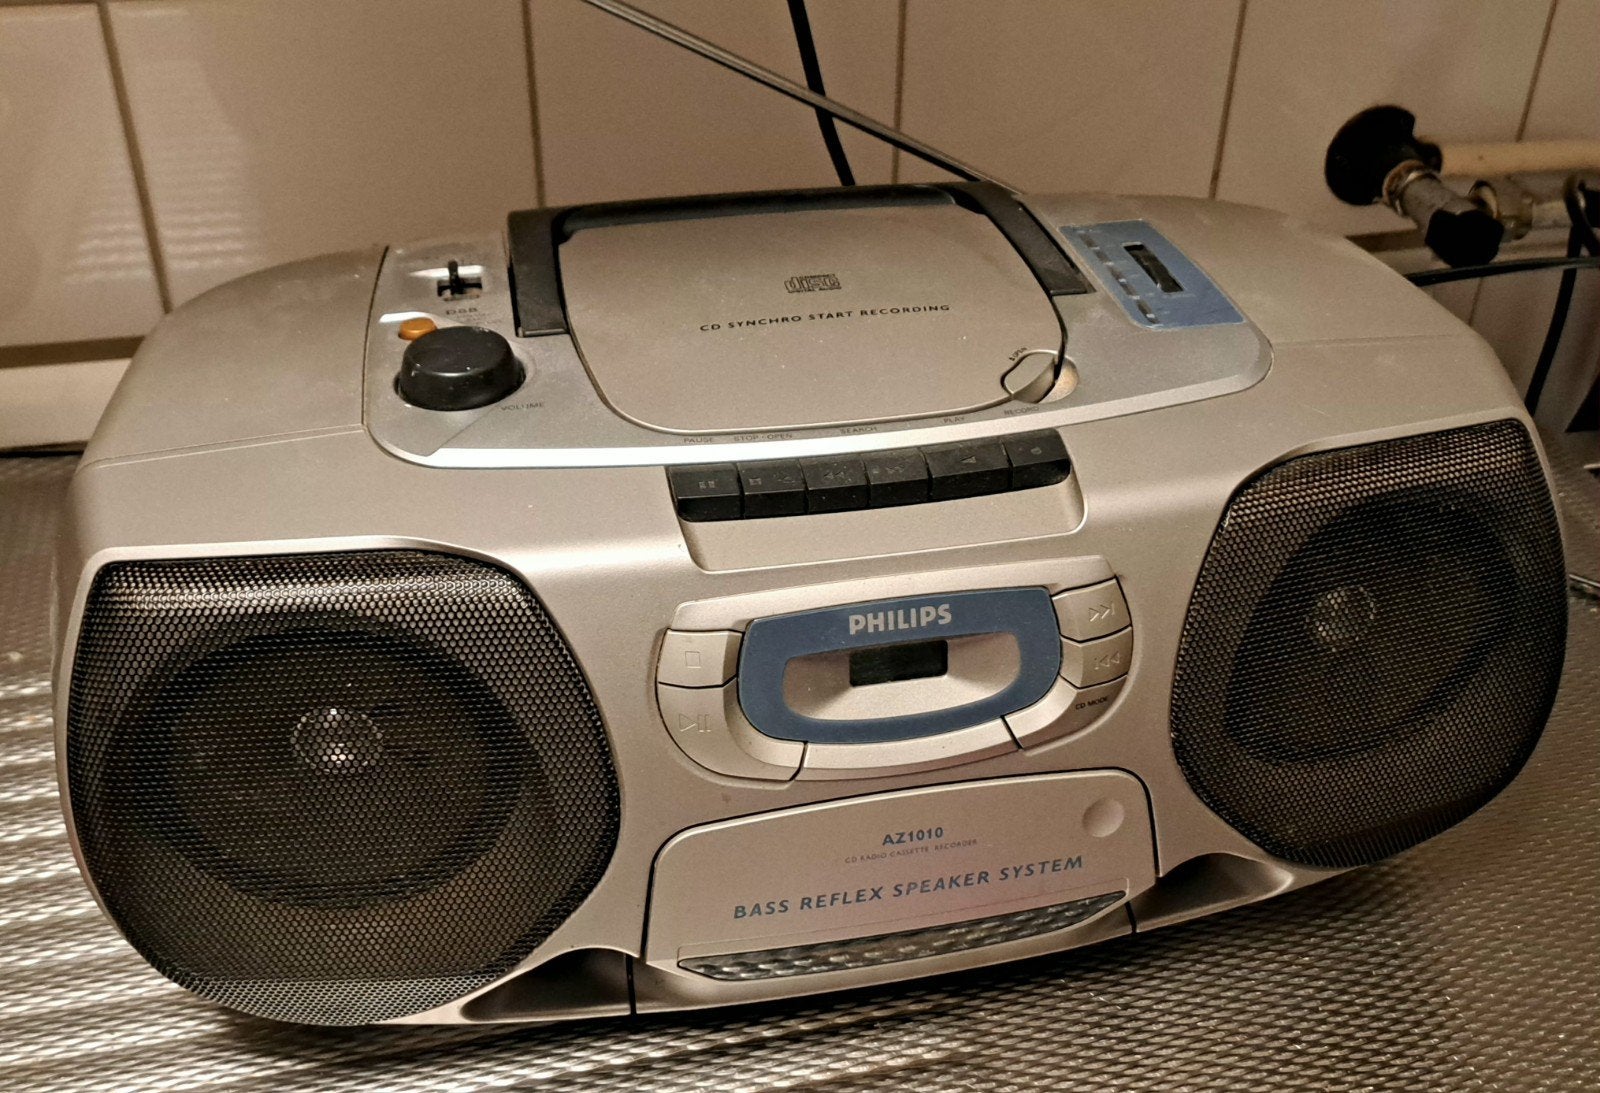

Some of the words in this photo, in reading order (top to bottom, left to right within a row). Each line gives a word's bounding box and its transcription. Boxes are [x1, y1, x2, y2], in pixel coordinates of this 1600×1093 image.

[700, 323, 722, 332] CD
[728, 314, 802, 330] SYNCHRO
[808, 309, 854, 321] START
[860, 303, 951, 316] RECORDING
[500, 402, 544, 410] VOLUME
[839, 426, 878, 435] SEARCH
[849, 604, 952, 635] PHILIPS
[1075, 702, 1086, 710] CD
[882, 826, 944, 846] AZ1010
[844, 856, 858, 864] CD
[860, 852, 887, 861] RADIO
[889, 846, 929, 857] CASSETTE
[934, 838, 978, 850] RECORDER
[733, 900, 790, 920] BASS
[799, 886, 884, 912] REFLEX
[892, 870, 991, 897] SPEAKER
[998, 855, 1084, 881] SYSTEM
